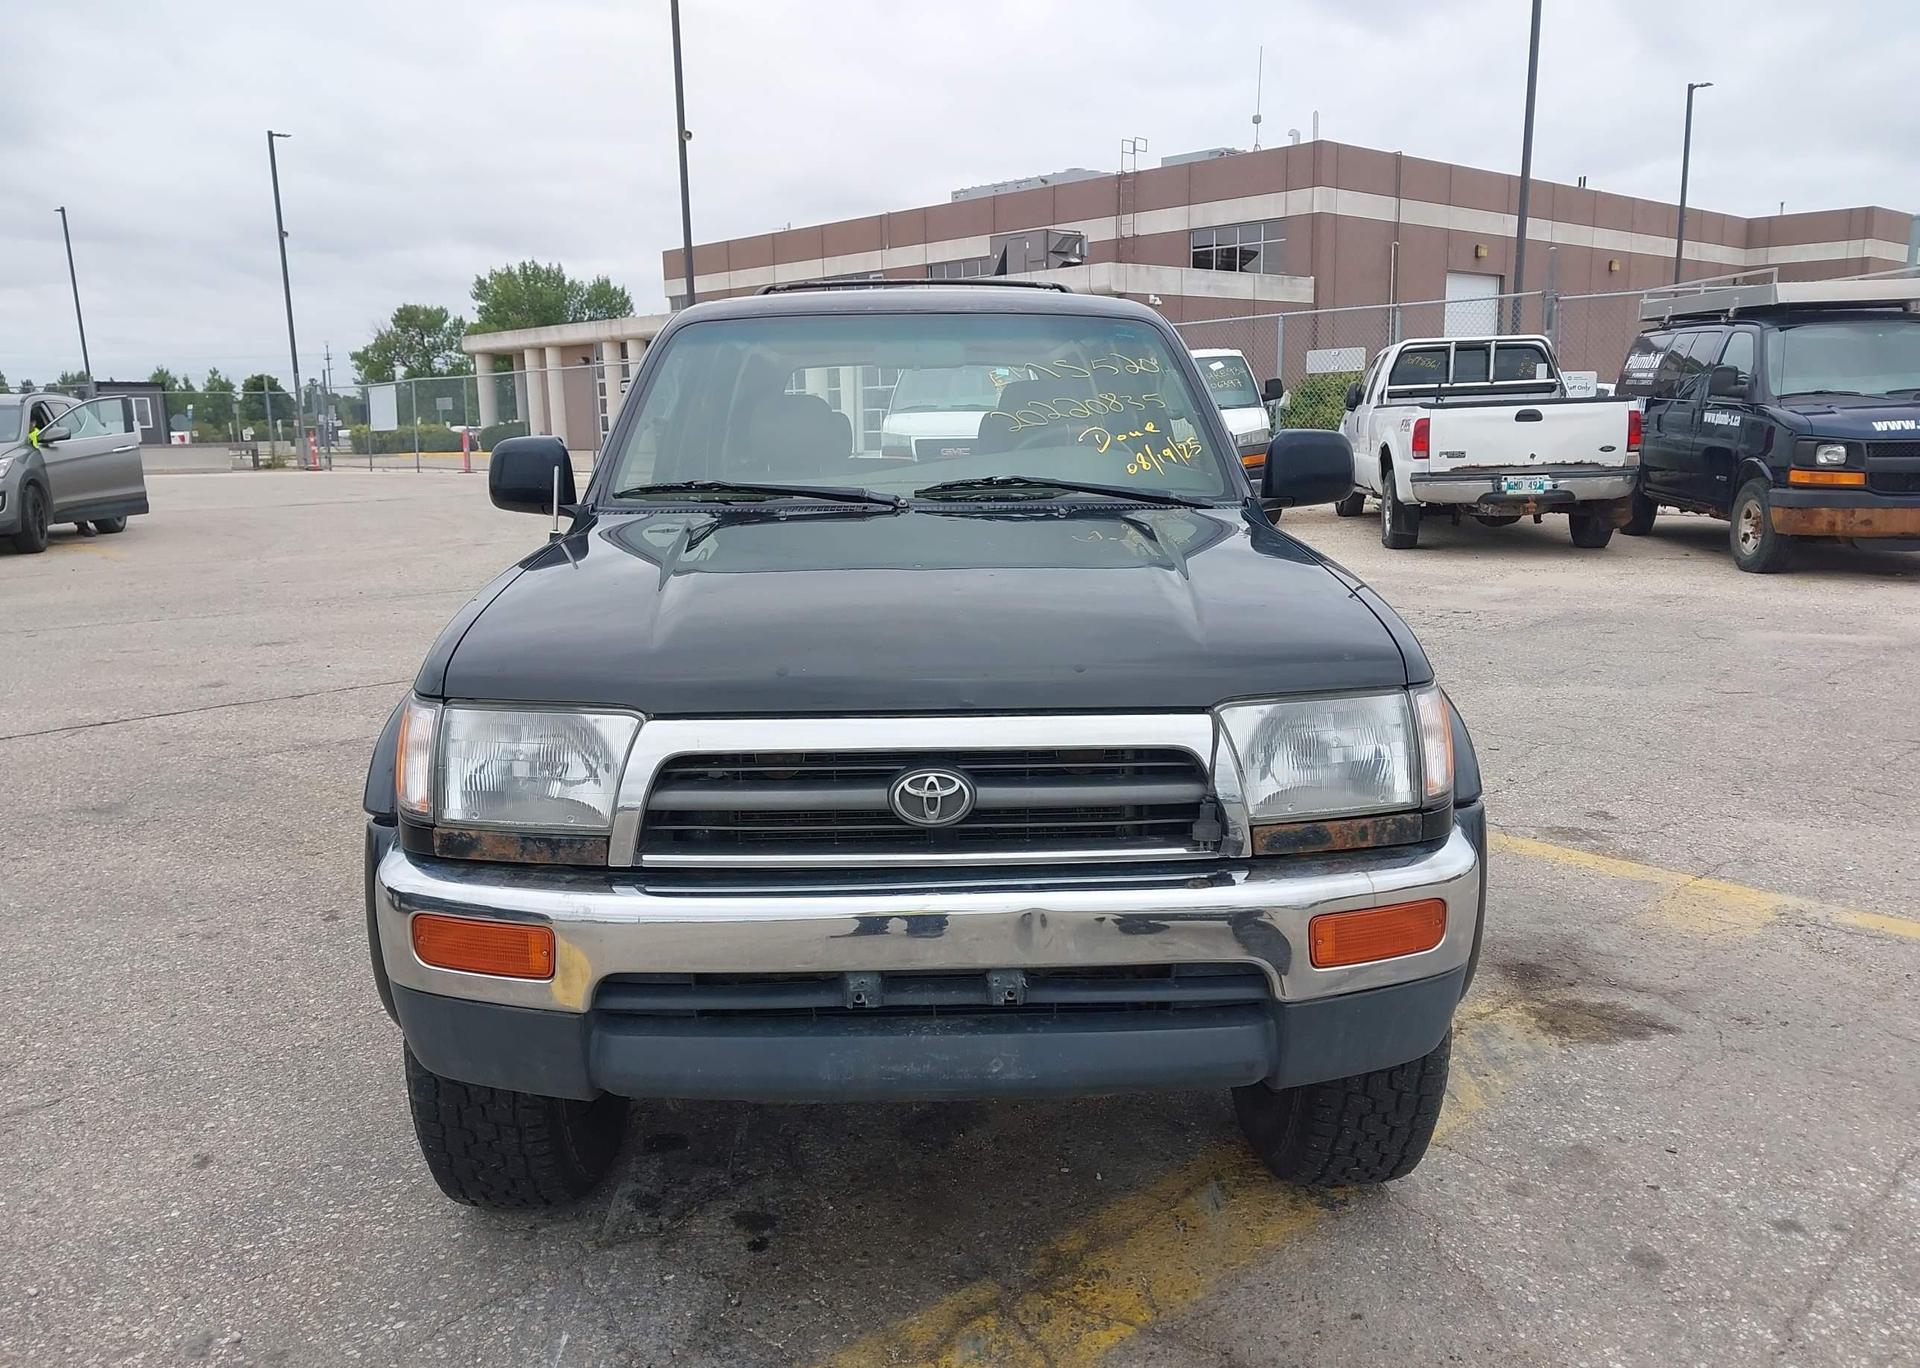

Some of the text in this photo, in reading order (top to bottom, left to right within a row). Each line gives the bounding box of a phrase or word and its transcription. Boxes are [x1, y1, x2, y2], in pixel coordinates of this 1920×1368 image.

[990, 392, 1167, 432] 20220835
[940, 447, 971, 456] GMC
[1078, 420, 1161, 454] Done
[1126, 437, 1202, 476] 08/19/25
